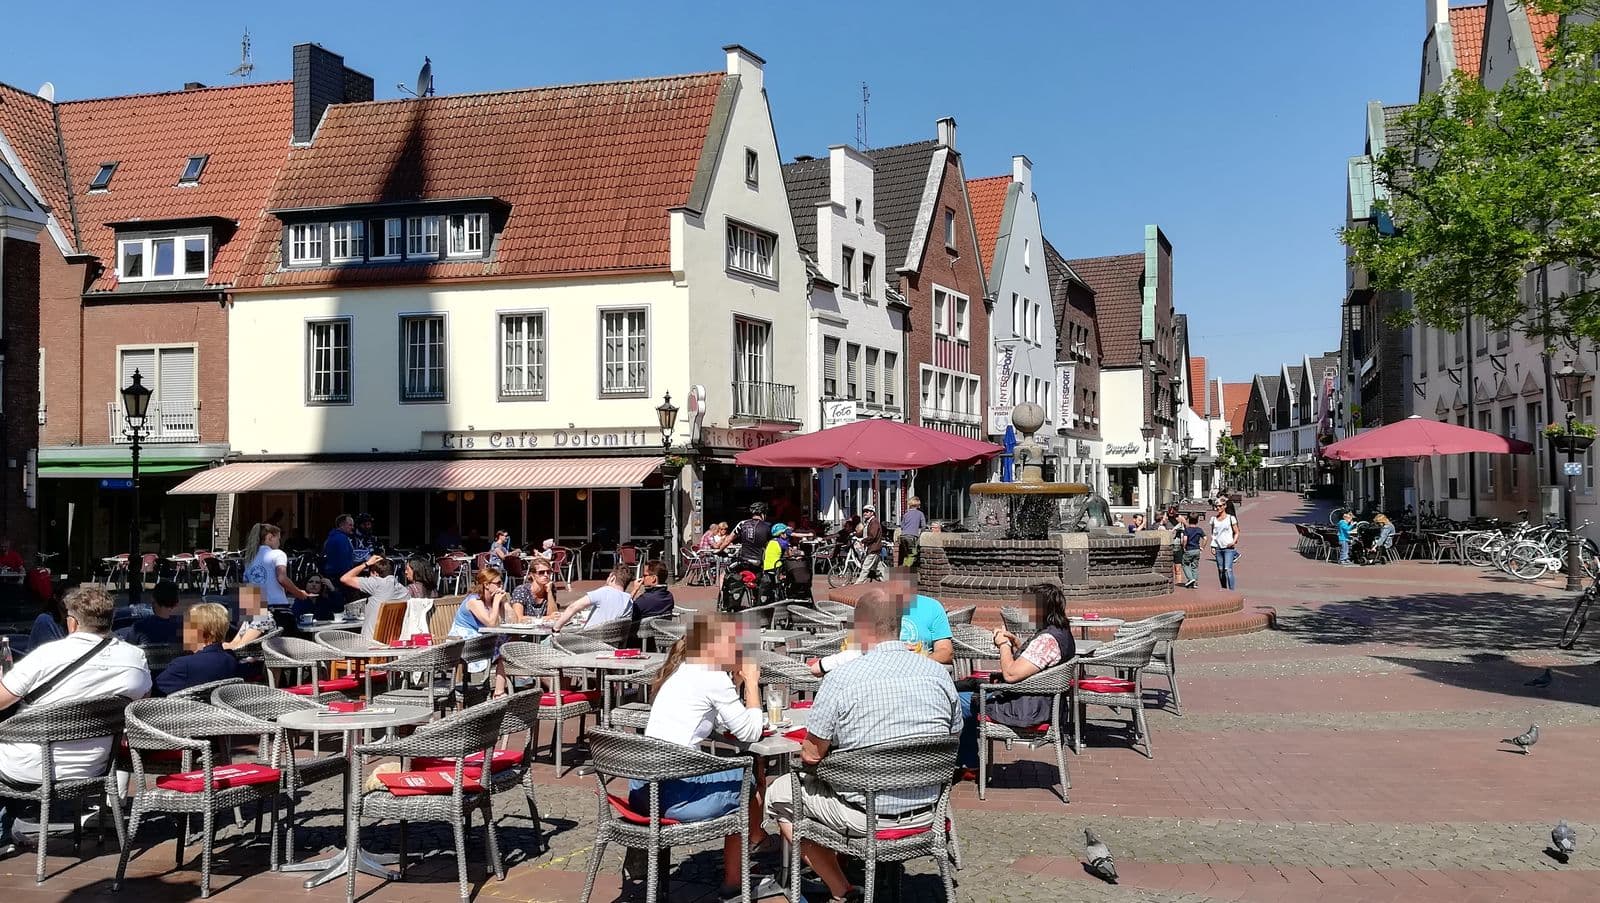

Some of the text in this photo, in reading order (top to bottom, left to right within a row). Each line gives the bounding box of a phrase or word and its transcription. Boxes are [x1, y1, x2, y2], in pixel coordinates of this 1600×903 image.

[999, 346, 1014, 403] INTERSPORT
[1061, 369, 1071, 417] INTERSPORT
[830, 403, 852, 418] Toto
[441, 431, 475, 449] Eis
[553, 430, 647, 447] Dolomiti
[704, 429, 722, 446] Eis
